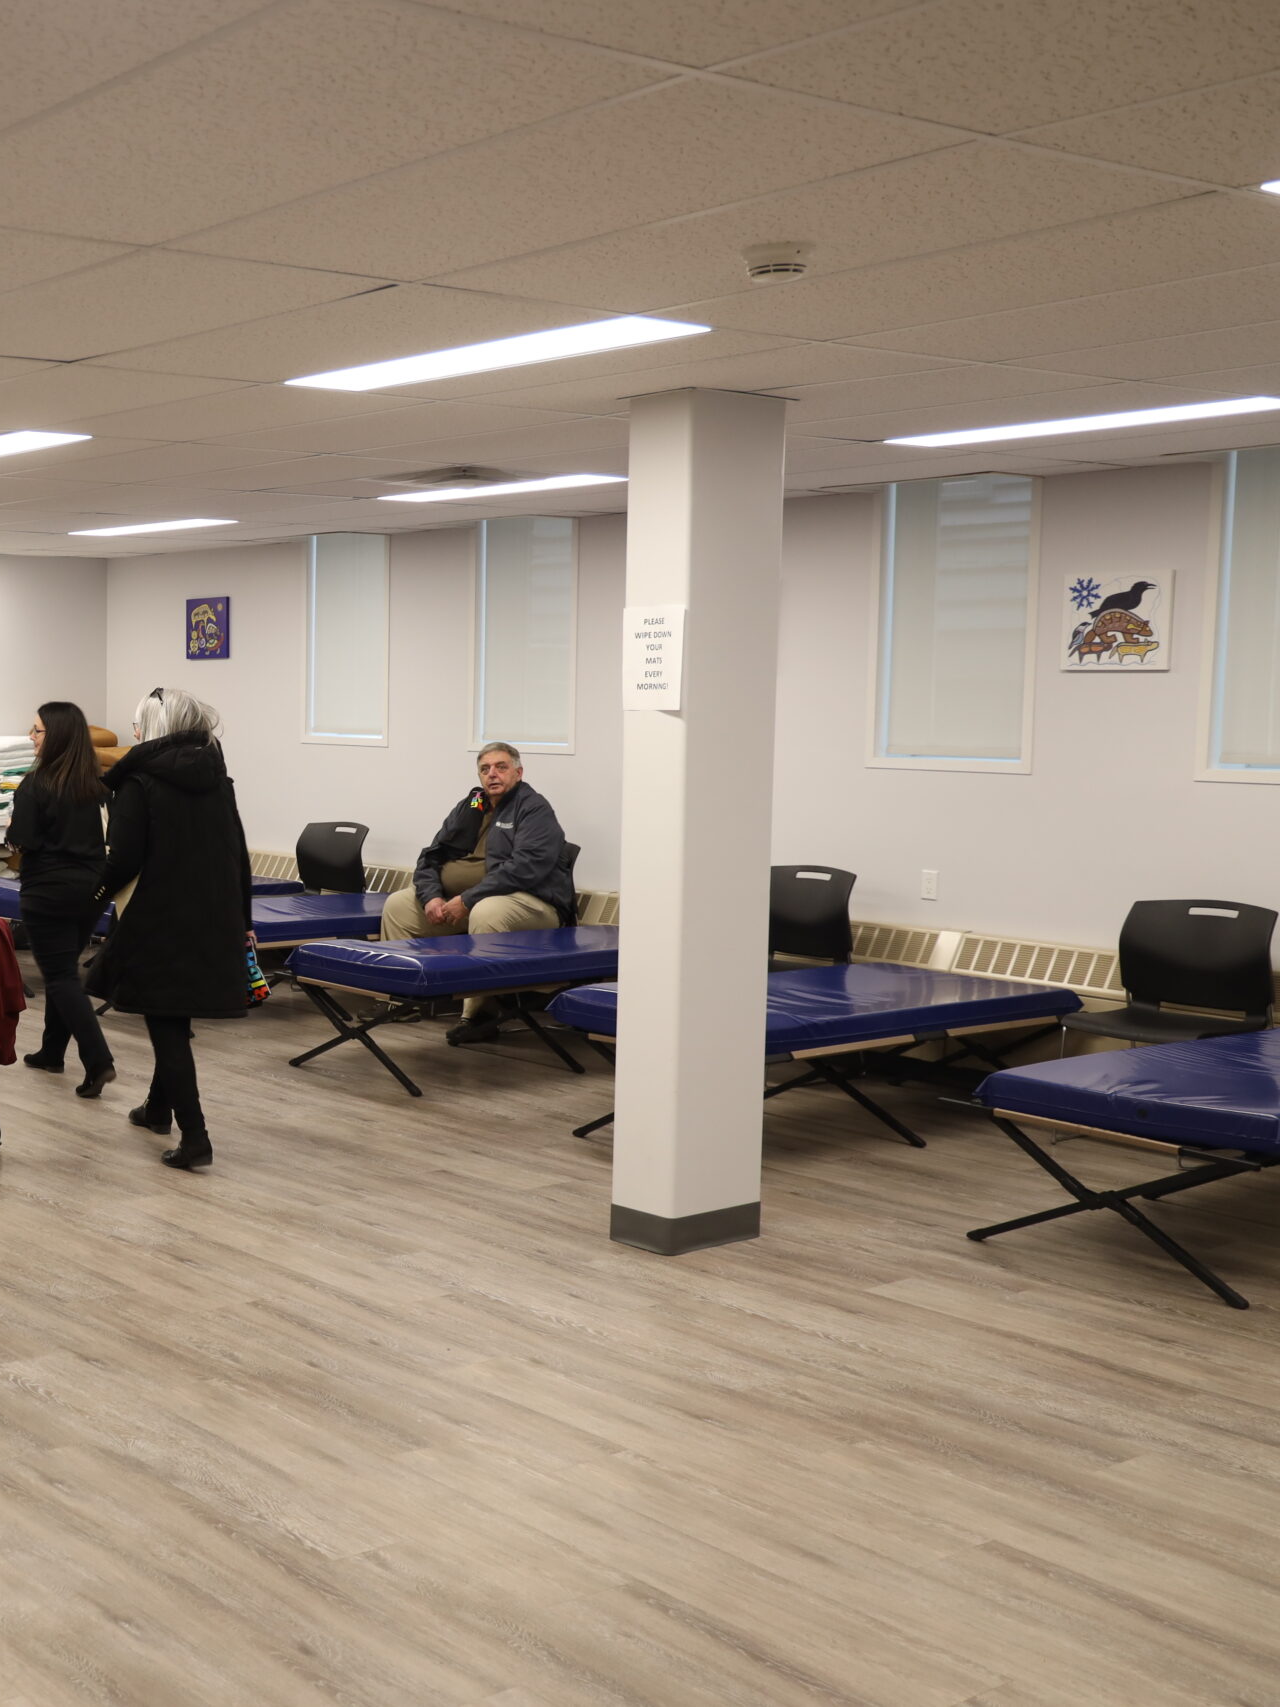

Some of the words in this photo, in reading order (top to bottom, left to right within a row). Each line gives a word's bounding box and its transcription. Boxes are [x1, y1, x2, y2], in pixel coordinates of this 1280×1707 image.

[643, 617, 665, 625] PLEASE
[634, 631, 652, 639] WIPE
[645, 657, 662, 665] MATS
[636, 683, 669, 691] MORNING!
